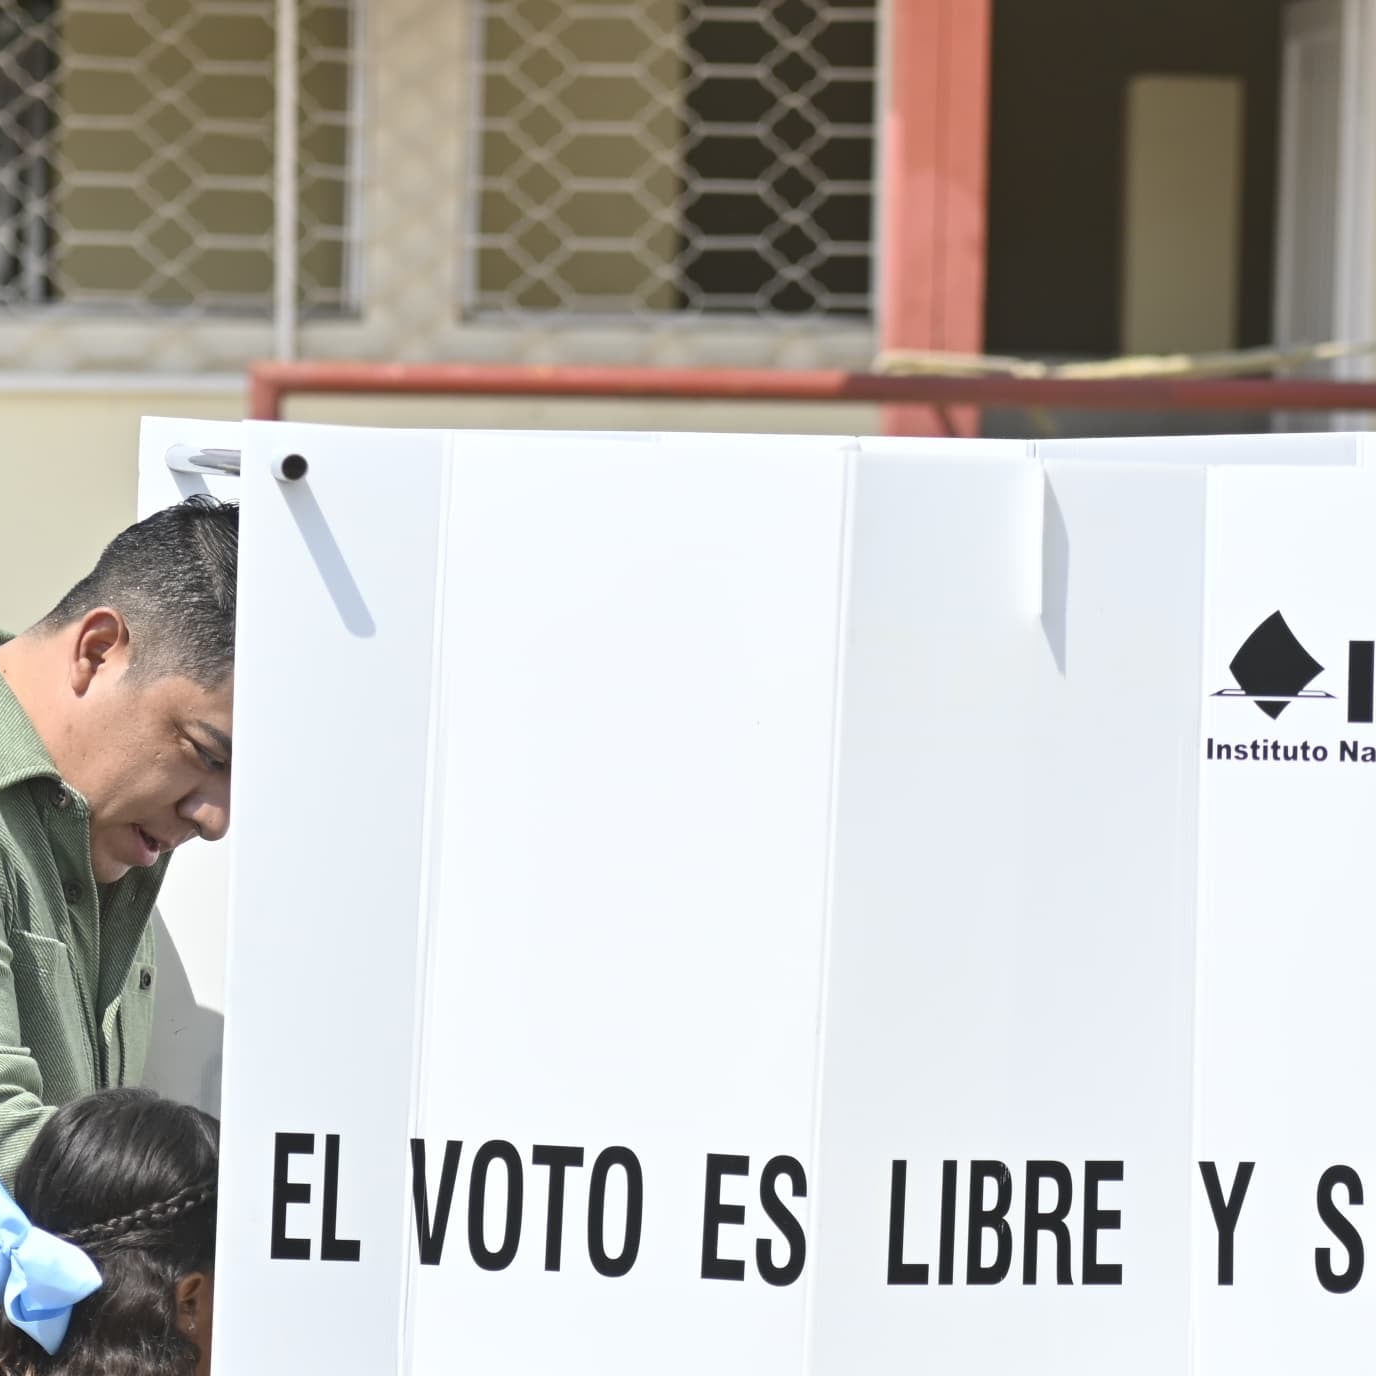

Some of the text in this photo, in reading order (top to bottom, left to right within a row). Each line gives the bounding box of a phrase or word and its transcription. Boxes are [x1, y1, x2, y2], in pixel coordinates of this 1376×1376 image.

[1207, 738, 1328, 762] Instituto
[270, 1132, 361, 1262] EL
[410, 1137, 643, 1278] VOTO
[700, 1153, 808, 1287] ES
[887, 1159, 1124, 1286] LIBRE
[1198, 1161, 1256, 1286] Y
